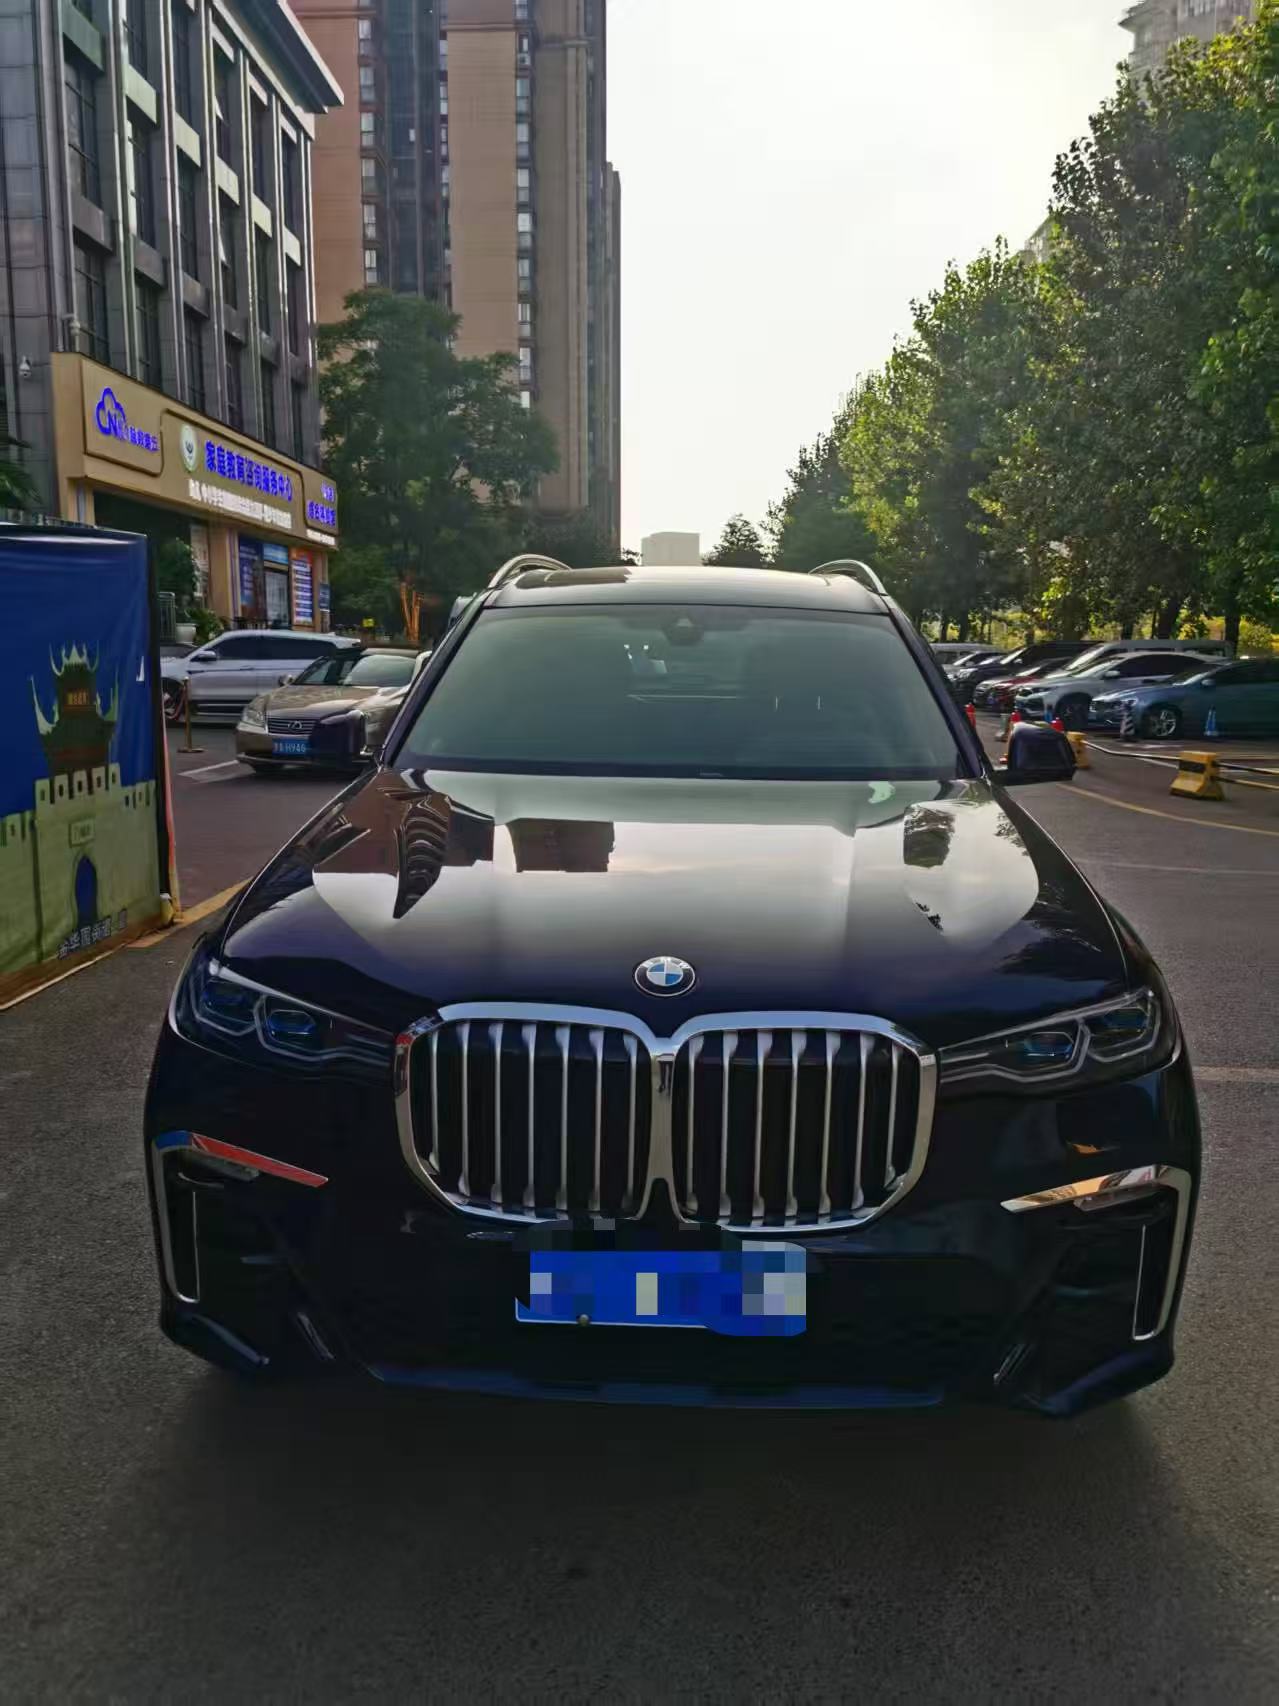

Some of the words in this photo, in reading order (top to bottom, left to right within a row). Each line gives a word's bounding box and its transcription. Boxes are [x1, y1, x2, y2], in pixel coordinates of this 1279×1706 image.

[205, 440, 292, 502] 家庭教育咨询服务中心
